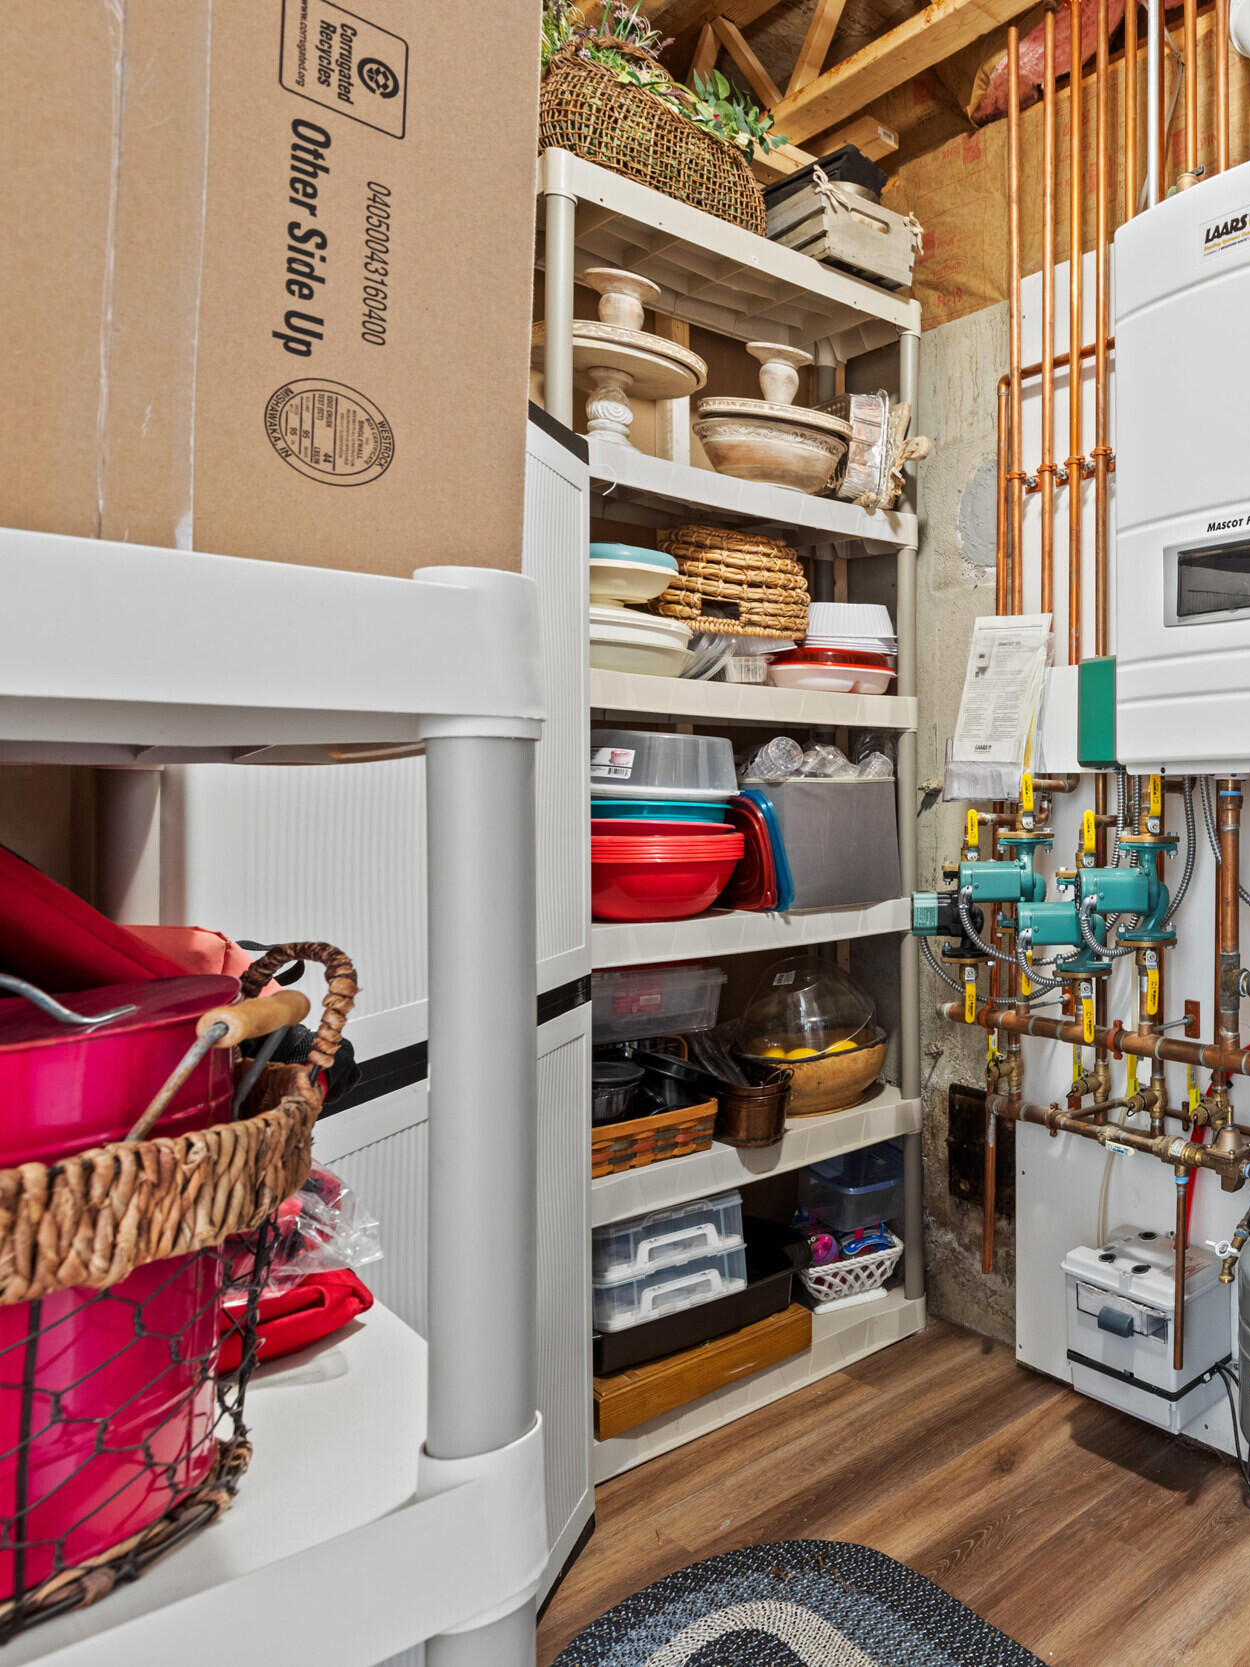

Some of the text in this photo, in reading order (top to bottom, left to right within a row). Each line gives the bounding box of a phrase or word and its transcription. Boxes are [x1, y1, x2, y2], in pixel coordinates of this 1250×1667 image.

[315, 20, 337, 87] Recycles
[337, 23, 358, 105] Corrugated
[272, 118, 331, 358] Other Side Up
[1205, 213, 1248, 244] LAARS
[361, 181, 391, 346] 04050043160400
[267, 387, 294, 446] MISHAWAKA,
[376, 420, 391, 469] WESTROCK
[279, 446, 292, 458] IN
